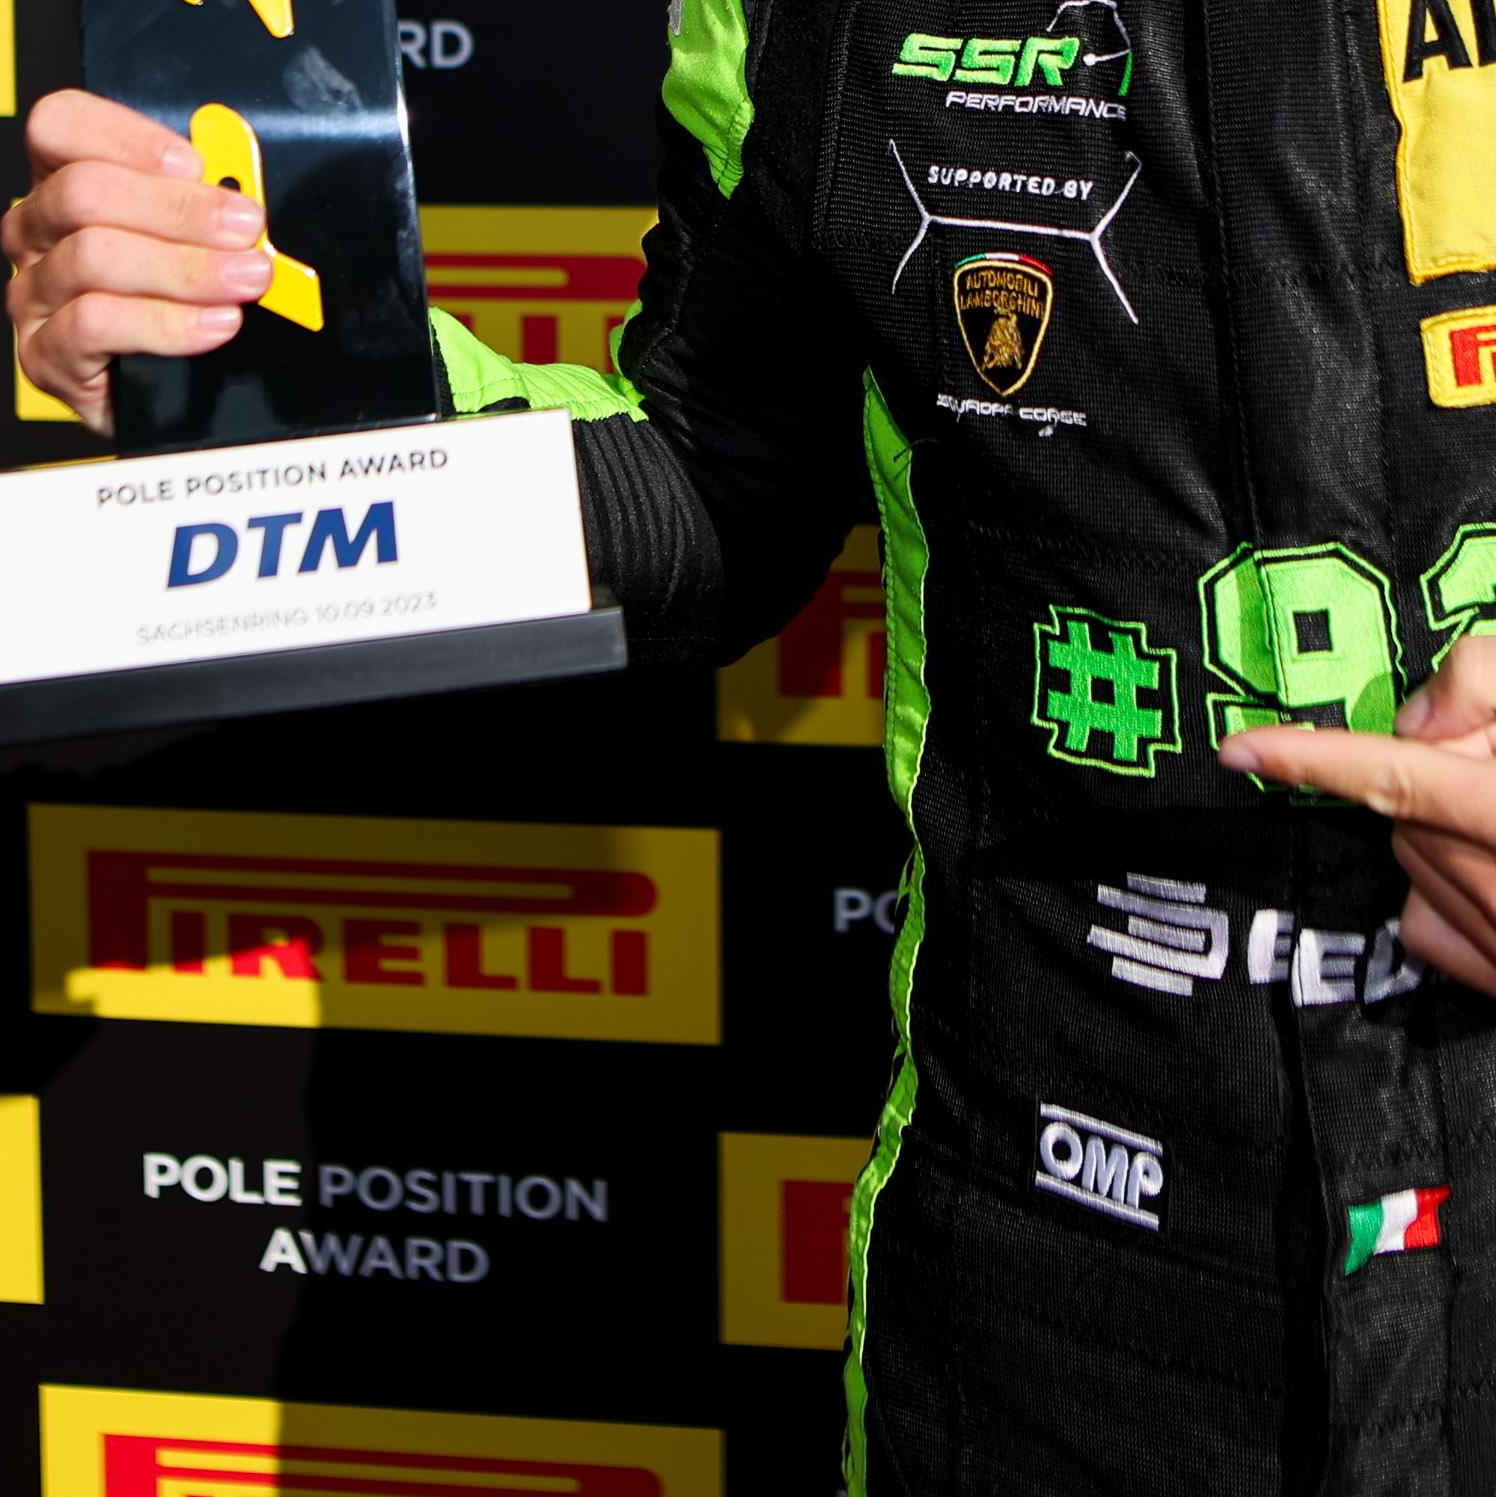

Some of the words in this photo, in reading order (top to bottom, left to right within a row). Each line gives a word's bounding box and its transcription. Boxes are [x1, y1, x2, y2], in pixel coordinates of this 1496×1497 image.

[891, 32, 1081, 87] SSR
[945, 89, 1127, 120] PERFORMANCE
[927, 165, 1055, 196] SUPPORTED
[1062, 178, 1094, 201] BY
[959, 289, 1045, 319] LAMBORGHINI
[964, 271, 1040, 298] AUTOMOBILI
[98, 478, 174, 508] POLE
[185, 461, 327, 499] POSITION
[339, 448, 449, 481] AWARD
[166, 500, 398, 590] DTM
[315, 590, 439, 625] 10.09.2023
[85, 848, 659, 997] PIRELLI
[143, 1153, 302, 1207] POLE
[318, 1164, 609, 1222] POSITION
[1039, 1121, 1164, 1210] OMP
[259, 1228, 490, 1283] AWARD
